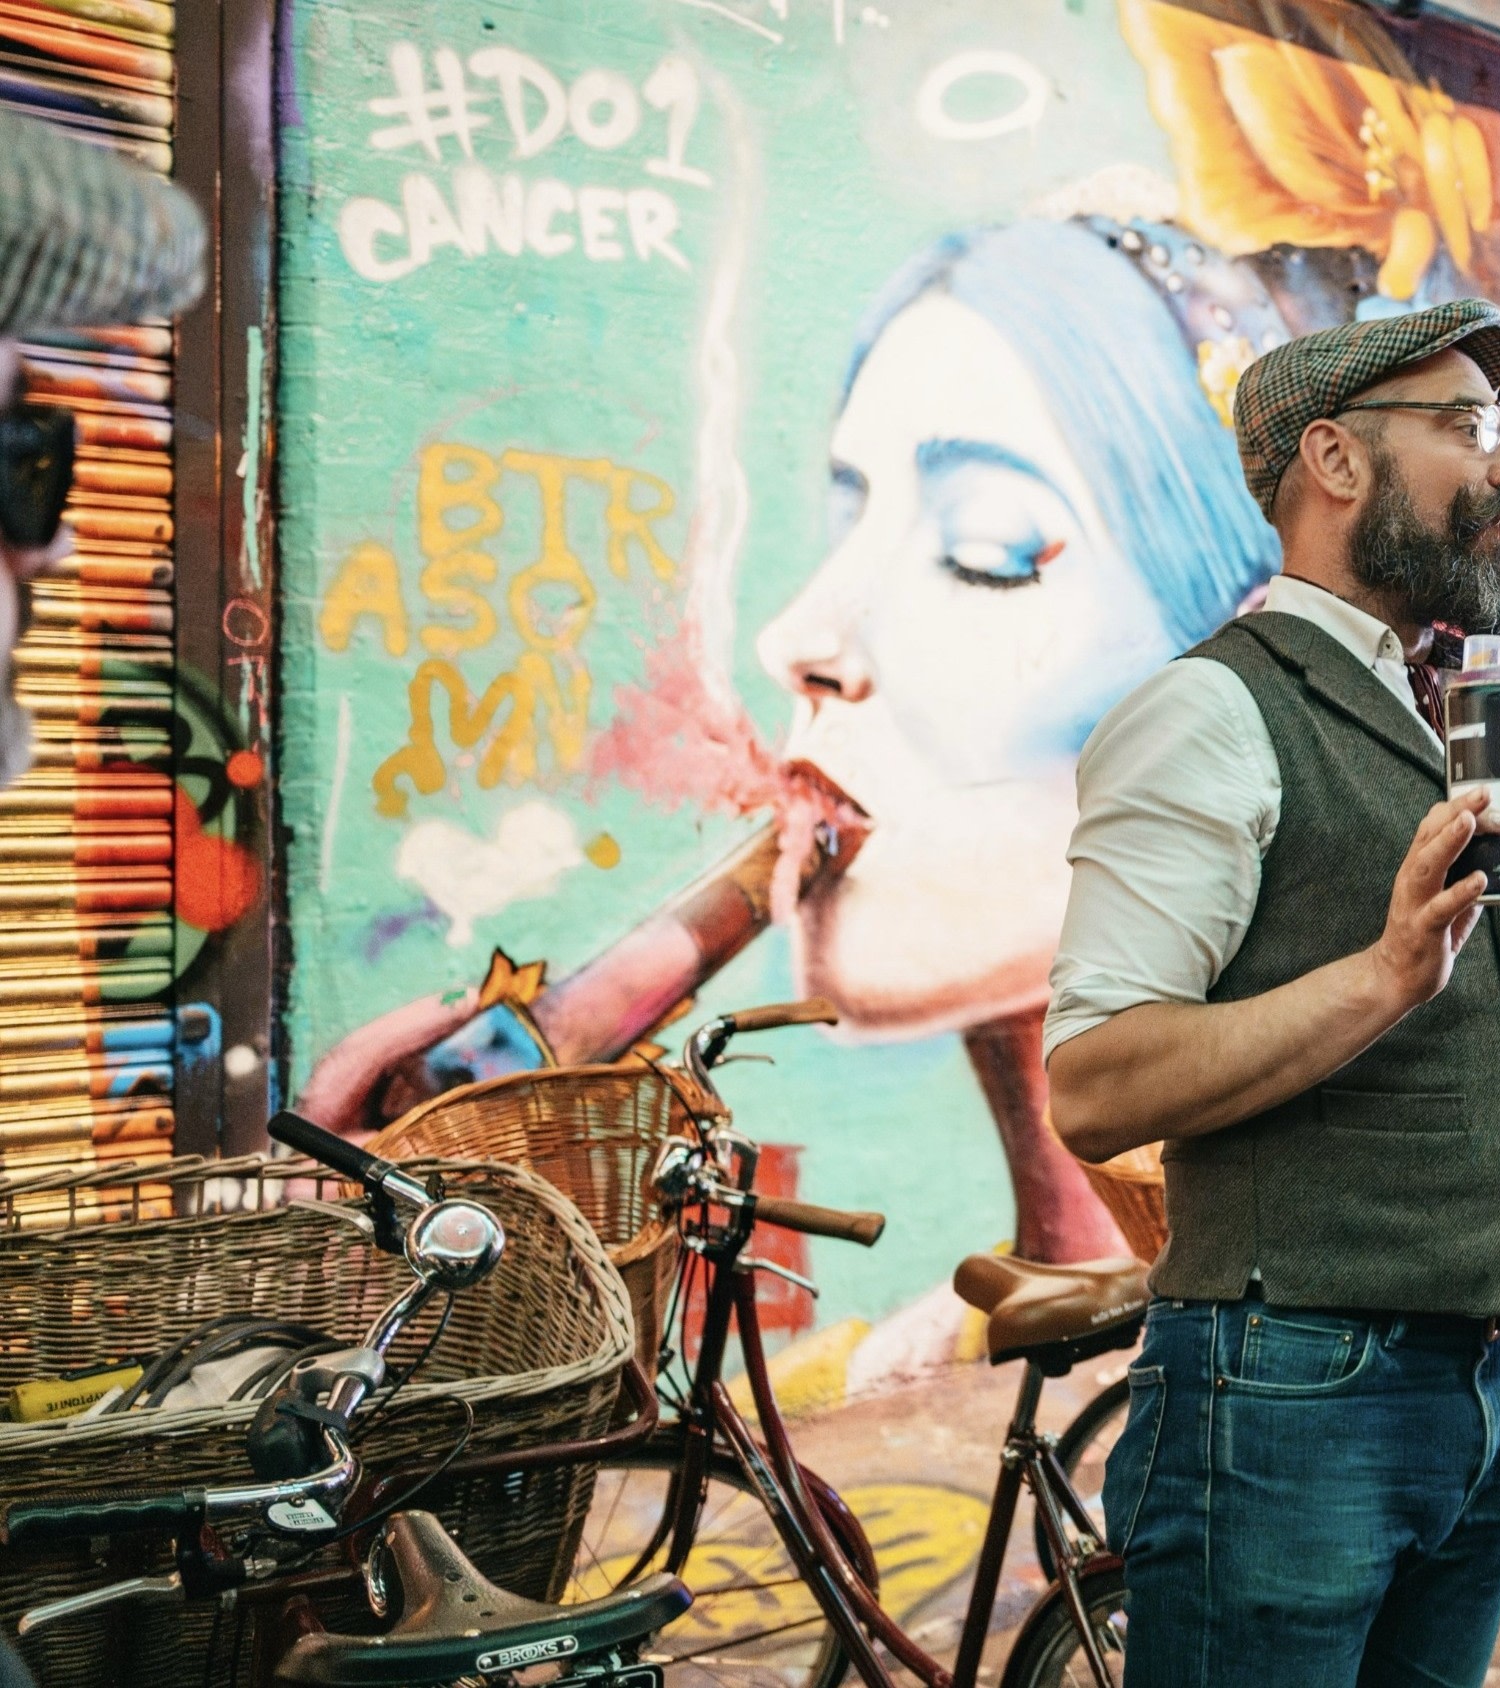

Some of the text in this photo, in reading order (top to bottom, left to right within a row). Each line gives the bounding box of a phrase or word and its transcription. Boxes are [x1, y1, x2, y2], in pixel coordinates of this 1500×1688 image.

[339, 163, 692, 283] CANCER
[417, 442, 677, 583] BTR
[46, 1392, 107, 1413] YPTONITE
[498, 1640, 559, 1666] BROOKS
